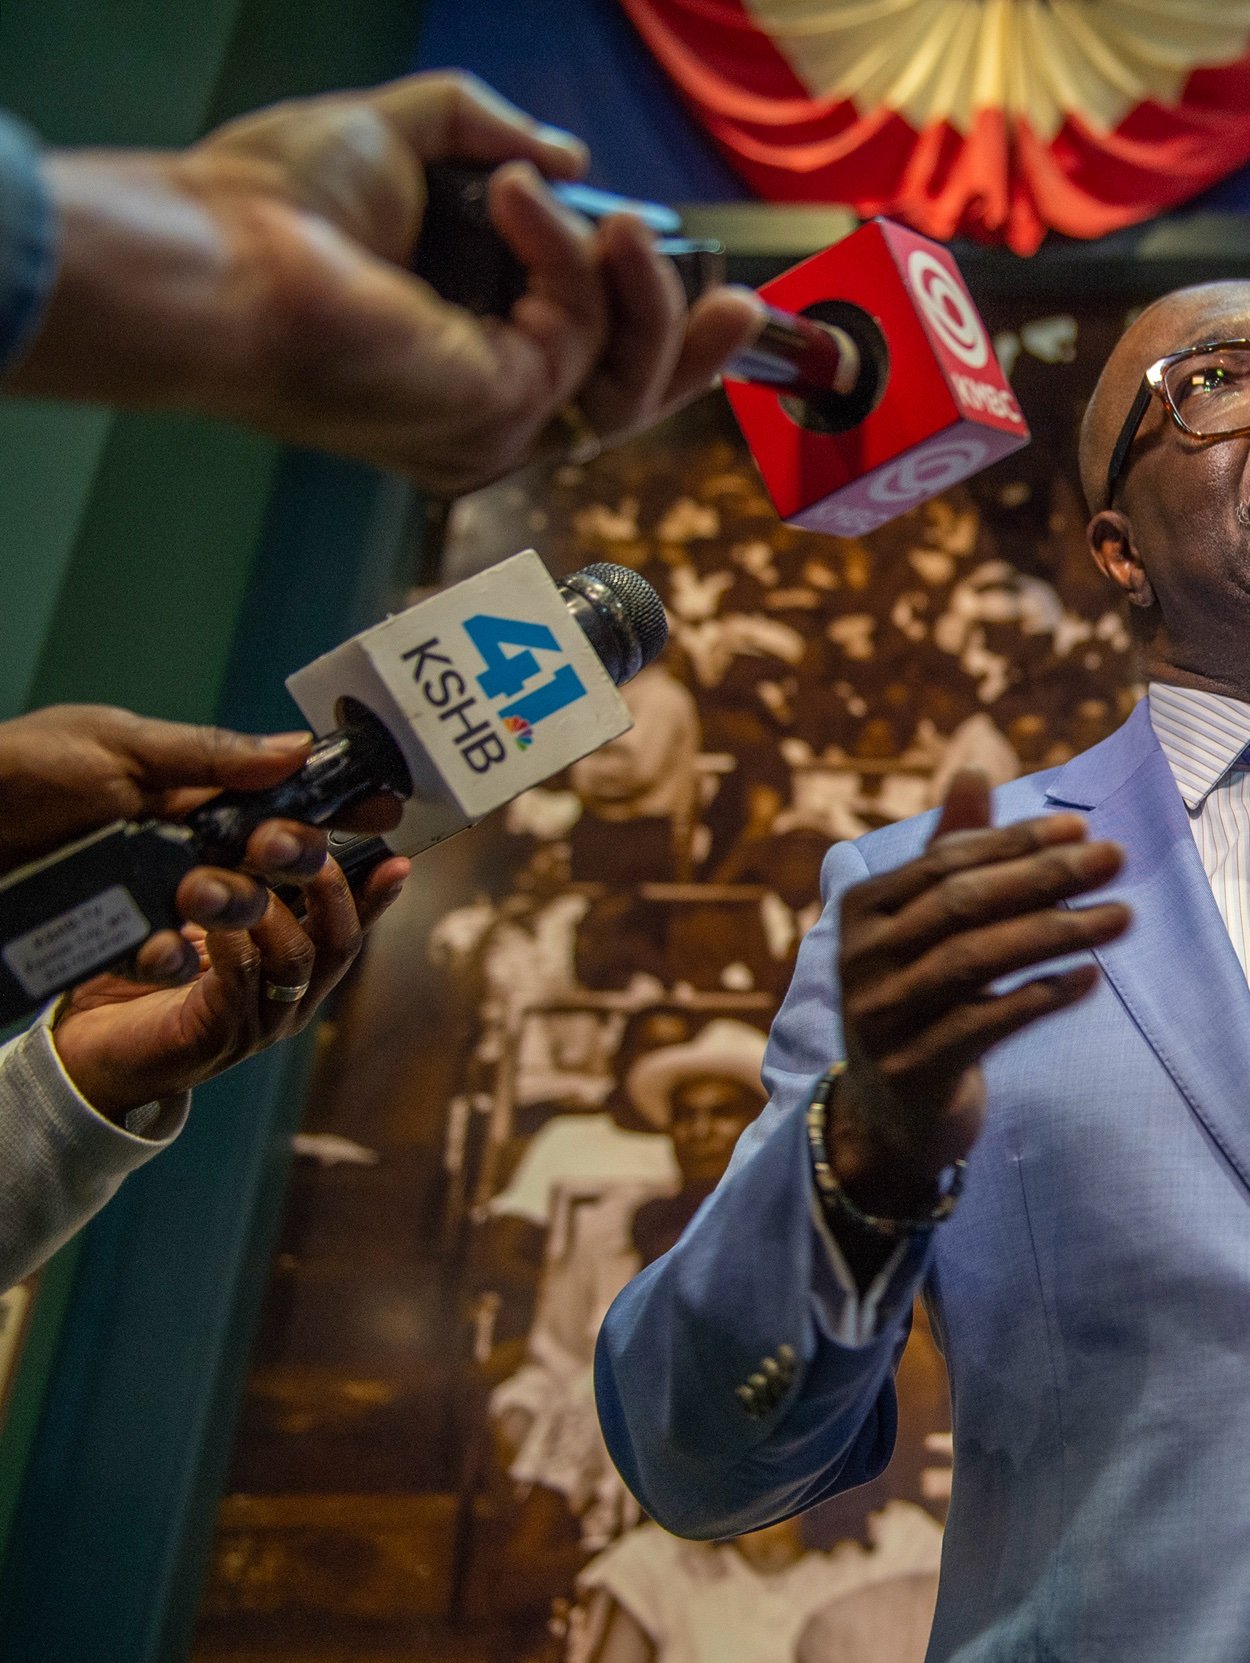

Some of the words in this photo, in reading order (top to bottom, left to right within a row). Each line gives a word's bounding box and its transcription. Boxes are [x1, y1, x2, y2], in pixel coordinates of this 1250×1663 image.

[950, 371, 1023, 424] KMBC
[401, 636, 507, 775] KSHB
[461, 614, 588, 726] 41
